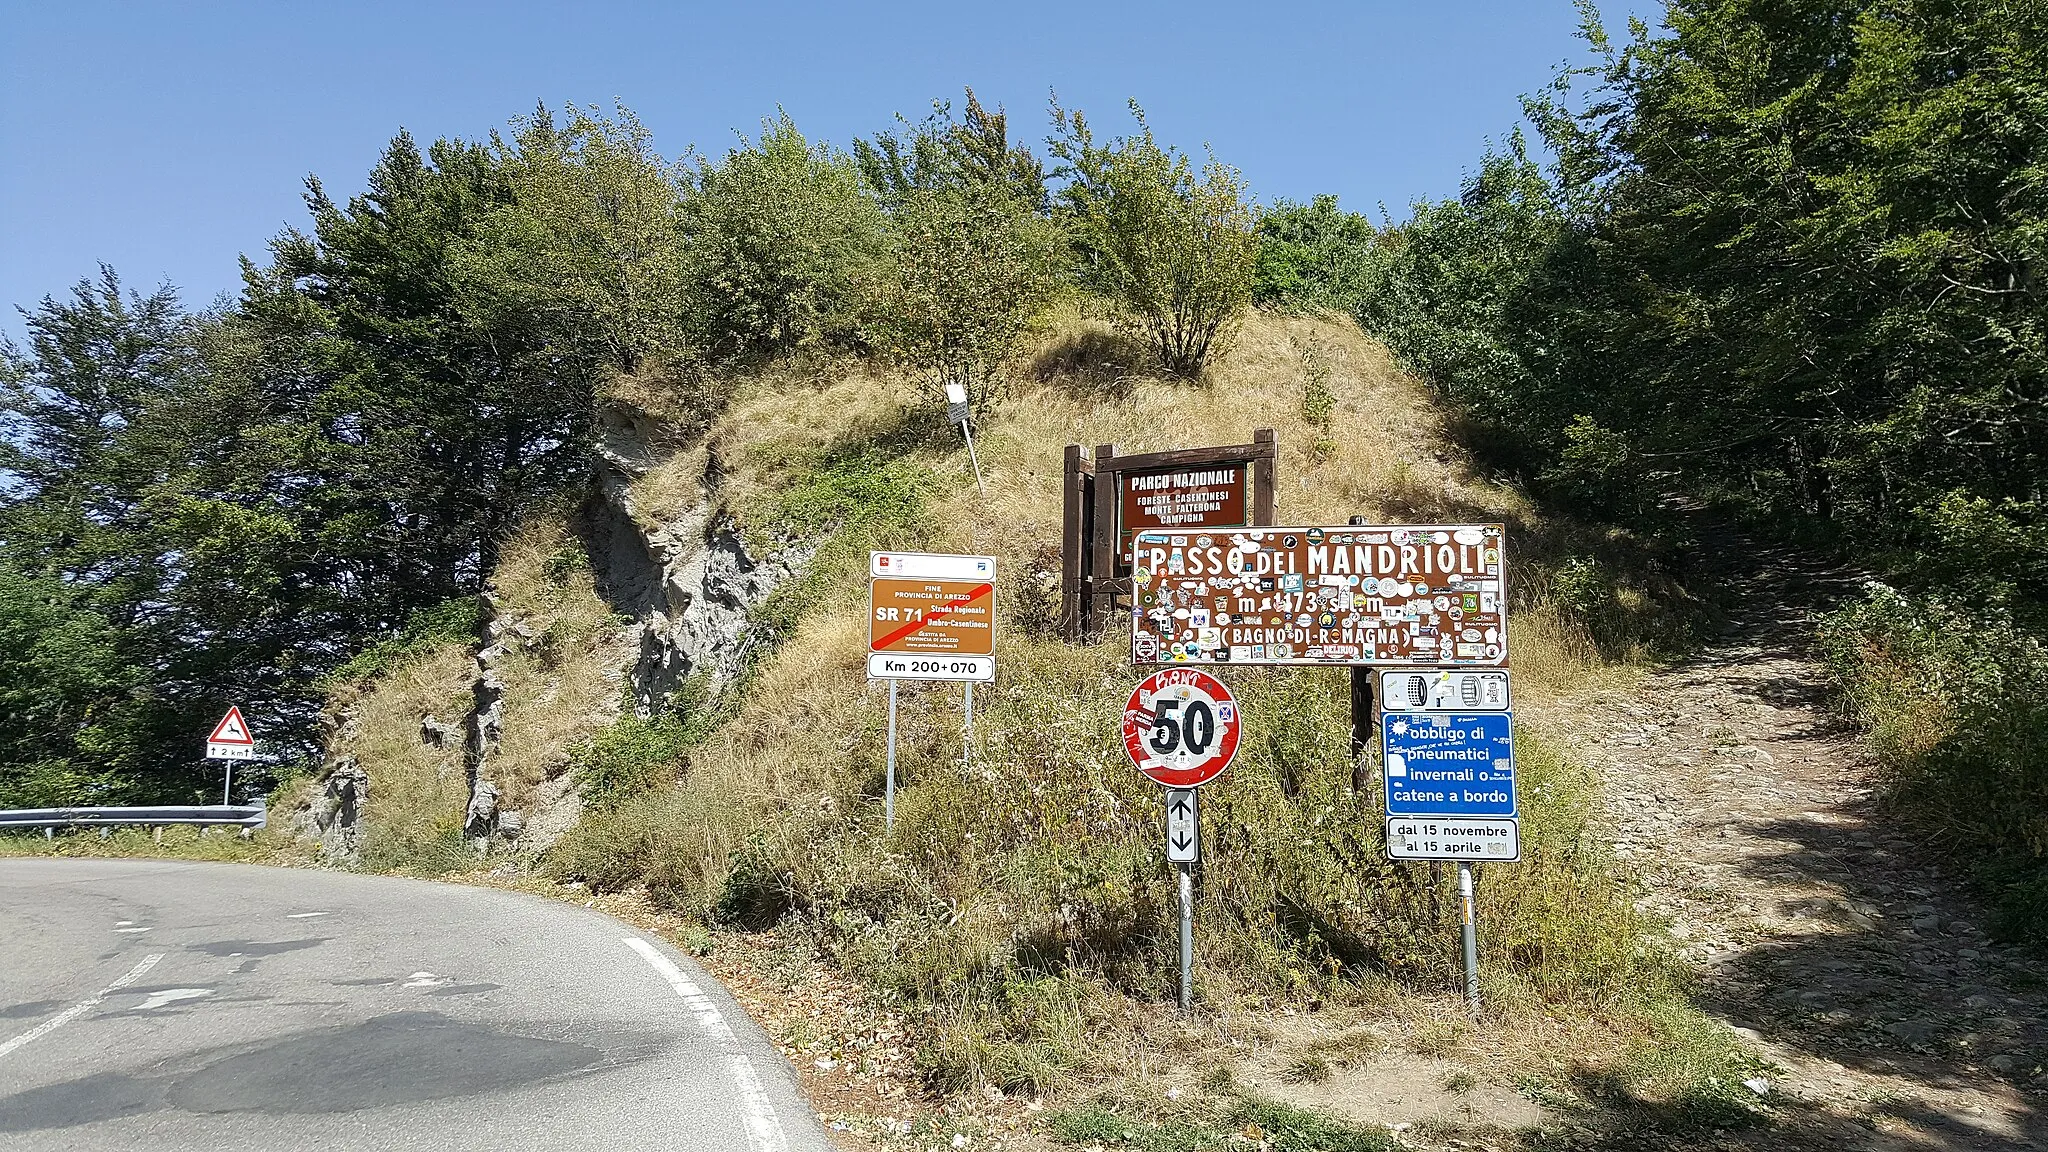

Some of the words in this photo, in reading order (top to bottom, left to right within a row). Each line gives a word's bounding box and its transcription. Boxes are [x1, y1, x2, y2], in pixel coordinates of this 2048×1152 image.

[1132, 474, 1170, 490] PARCO
[1173, 470, 1235, 488] NAZIONALE
[1138, 495, 1171, 505] FORESTE
[1175, 491, 1229, 503] CASENTINESI
[1145, 505, 1171, 515] MONTE
[1176, 502, 1220, 513] FALTERONA
[1160, 514, 1204, 524] CAMPIGNA
[1151, 547, 1244, 575] PASSO
[1257, 552, 1294, 575] DEI
[1308, 545, 1484, 574] MANDRIOLI
[876, 607, 899, 621] SR
[904, 608, 922, 622] 71
[931, 605, 952, 613] Strada
[954, 606, 985, 615] Regionale
[928, 619, 988, 628] Umbro-Casentinese
[885, 661, 906, 671] Km
[912, 662, 976, 673] 200+070
[1150, 700, 1214, 754] 50
[1410, 727, 1466, 741] obbligo
[1471, 727, 1484, 739] di
[1407, 748, 1489, 761] pneumatici
[1410, 768, 1473, 780] invernali
[1479, 771, 1488, 781] o
[1394, 790, 1444, 802] catene
[1449, 793, 1458, 802] a
[1464, 790, 1508, 802] bordo
[1398, 825, 1418, 835] dal
[1423, 825, 1437, 835] 15
[1444, 826, 1507, 837] novembre
[1407, 842, 1418, 852] al
[1424, 842, 1438, 852] 15
[1444, 843, 1482, 854] aprile
